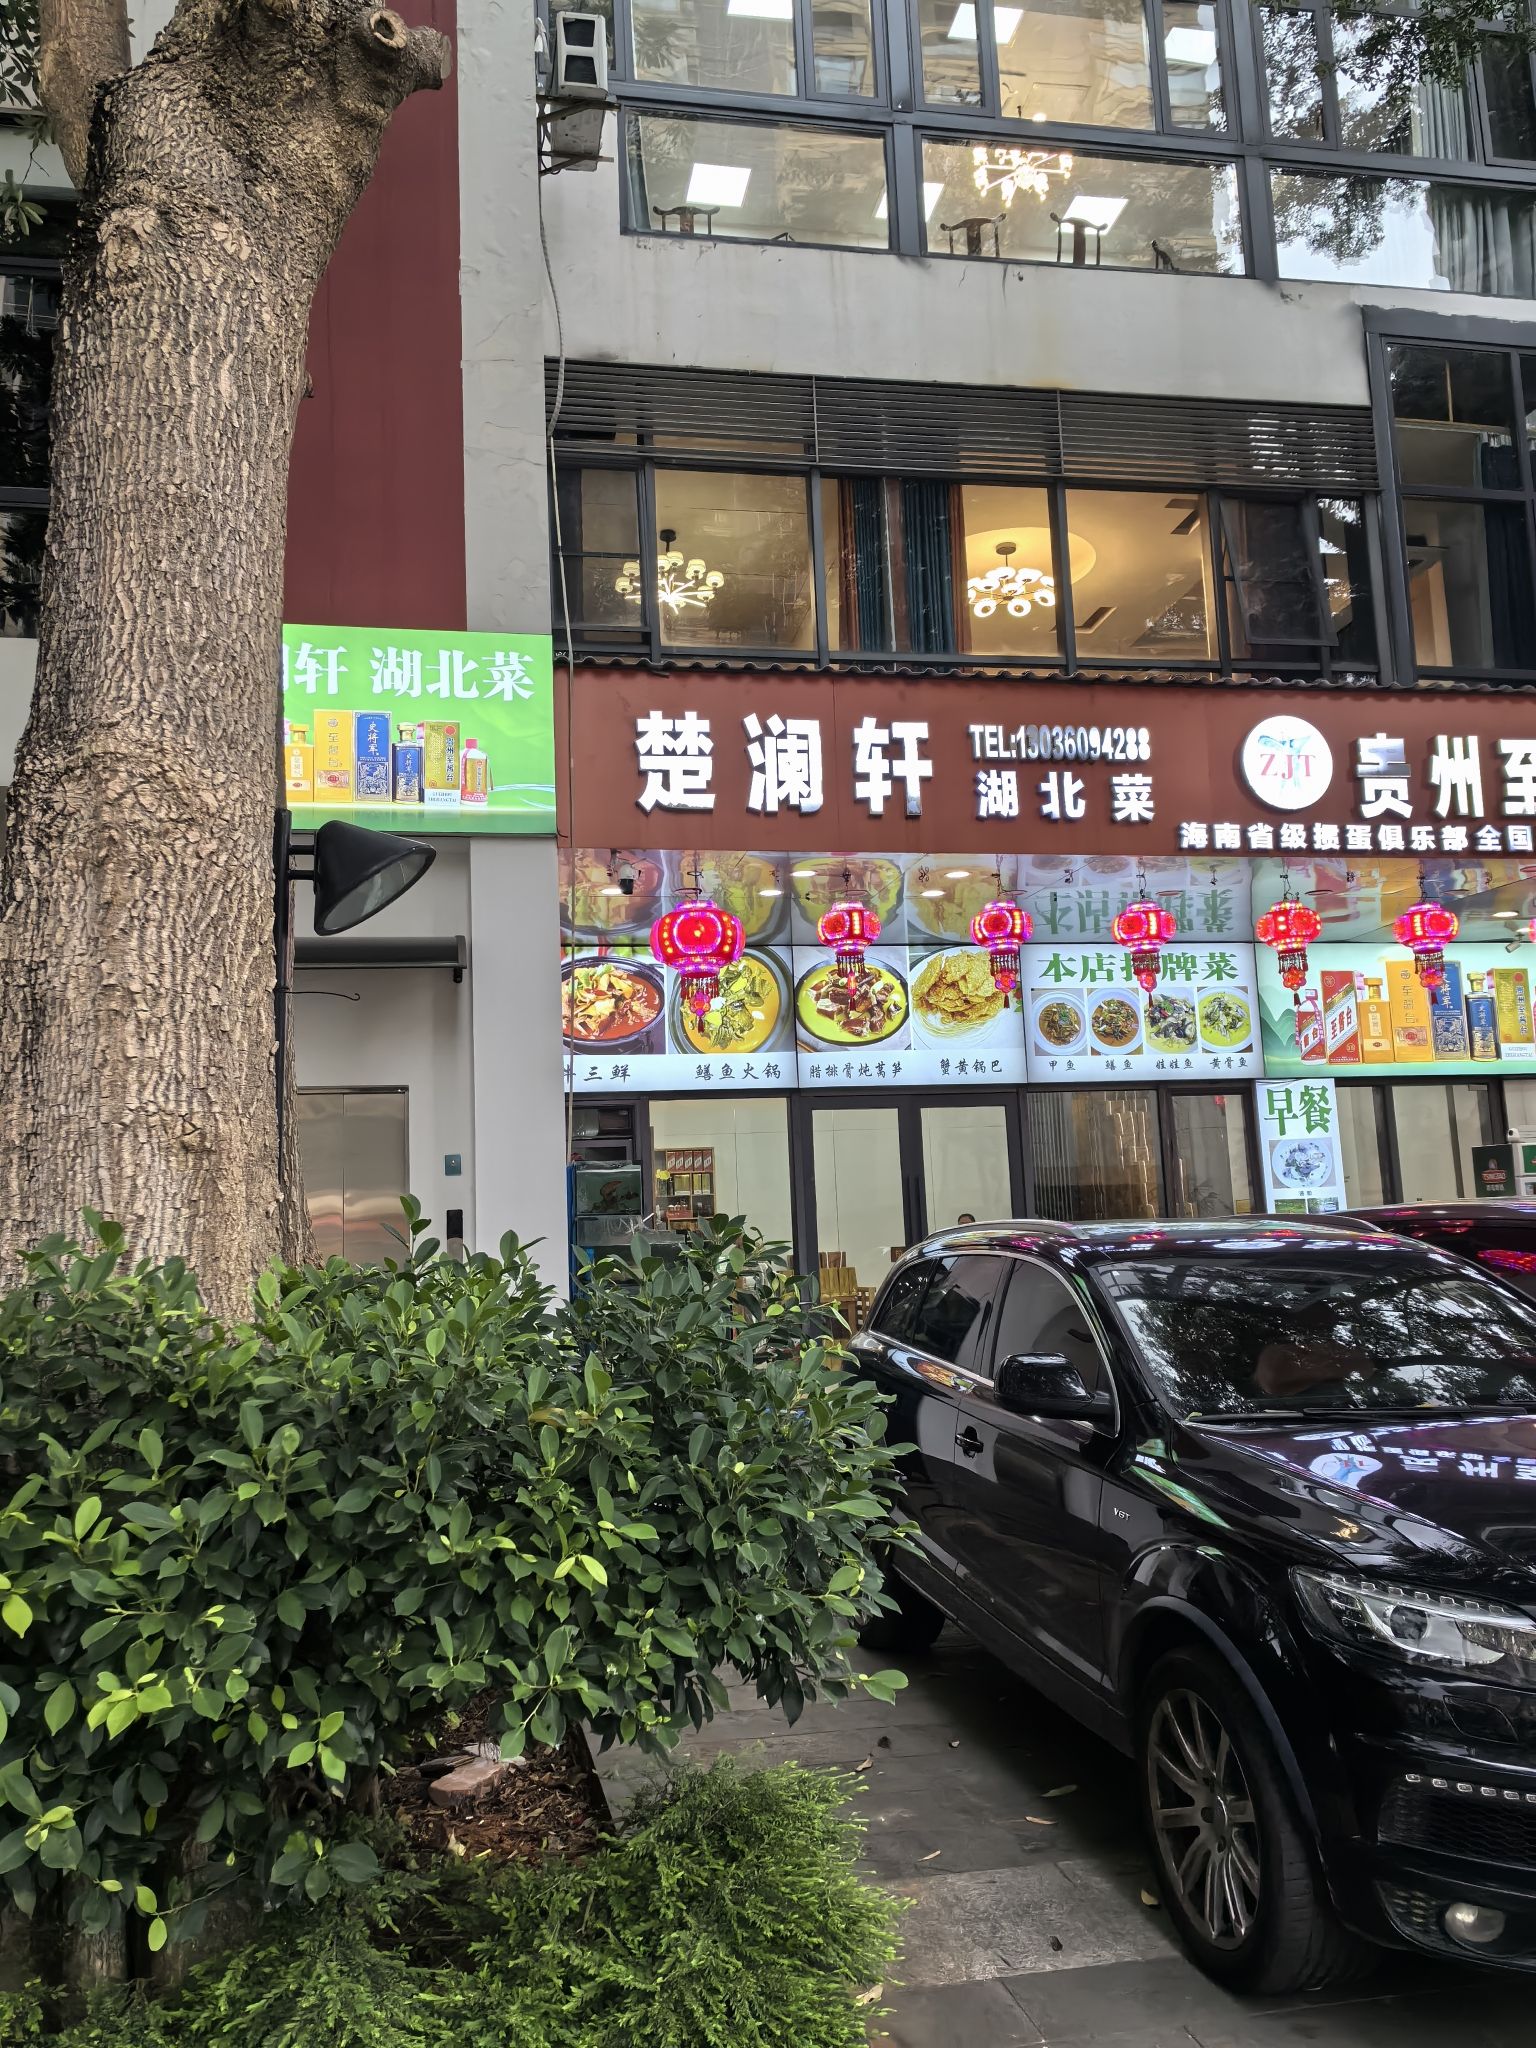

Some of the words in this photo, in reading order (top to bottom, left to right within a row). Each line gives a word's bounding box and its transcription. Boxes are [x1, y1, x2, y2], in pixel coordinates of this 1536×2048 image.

[283, 642, 349, 695] 轩
[369, 646, 535, 701] 湖北菜
[635, 710, 933, 816] 楚澜轩
[1259, 753, 1316, 780] ZJT
[976, 769, 1156, 822] 湖北菜
[695, 1062, 781, 1081] 鳝鱼火锅
[940, 1058, 1003, 1076] 蟹黄锅巴
[1048, 1060, 1077, 1071] 甲鱼
[1156, 1059, 1194, 1070] 娃娃鱼
[1264, 1085, 1332, 1136] 早餐
